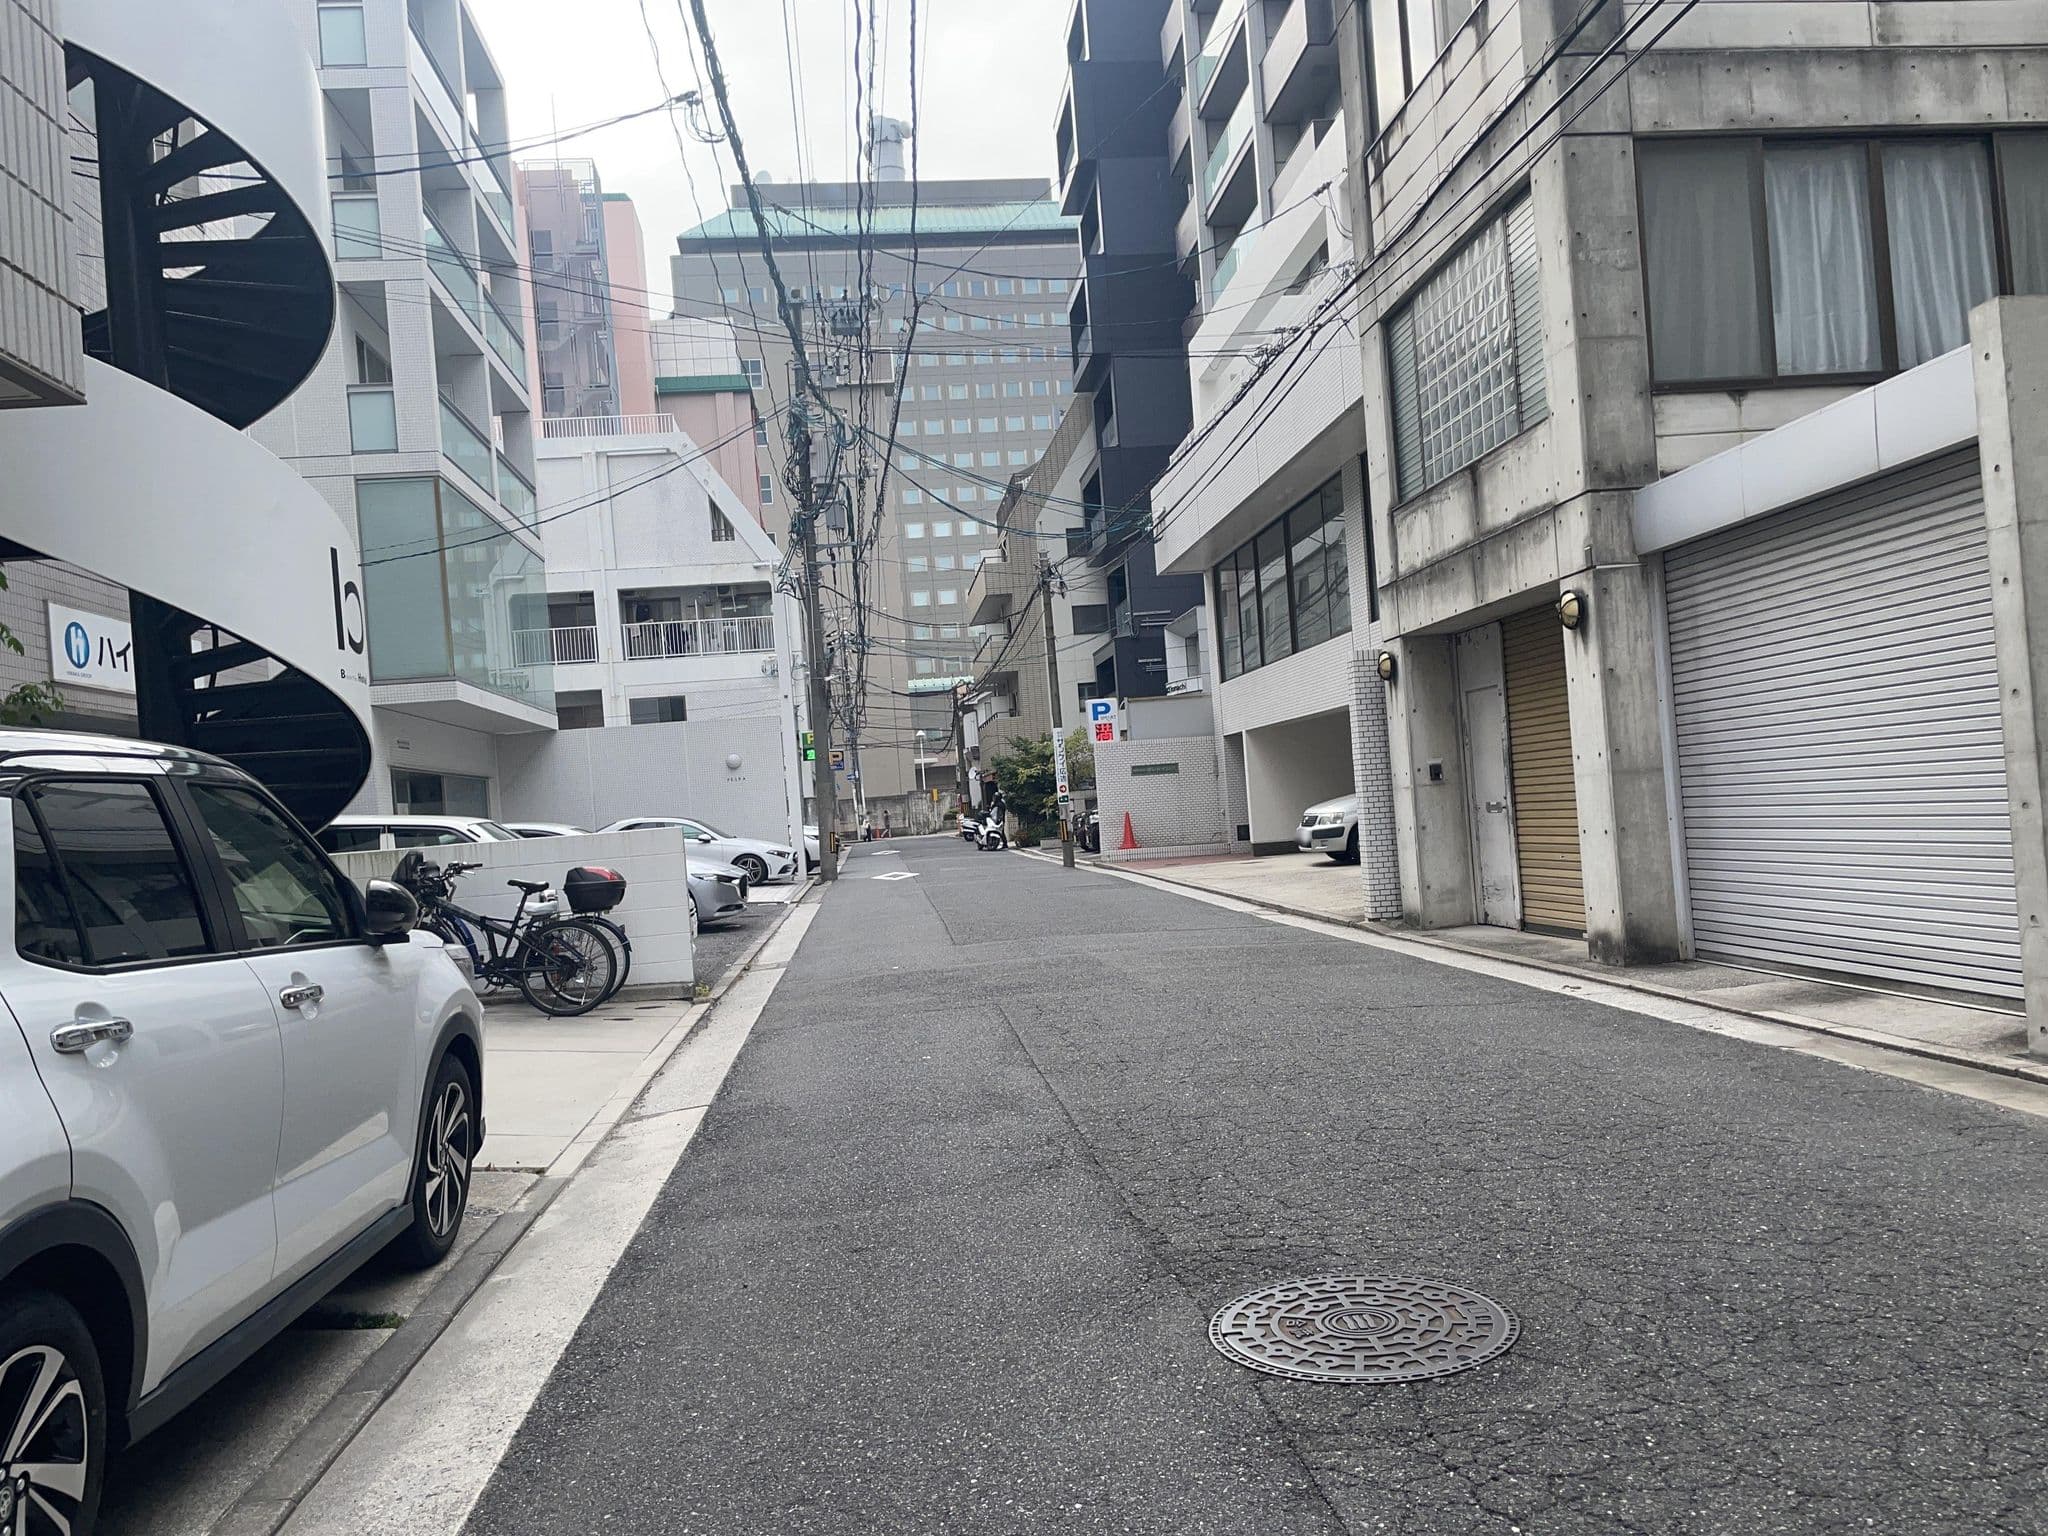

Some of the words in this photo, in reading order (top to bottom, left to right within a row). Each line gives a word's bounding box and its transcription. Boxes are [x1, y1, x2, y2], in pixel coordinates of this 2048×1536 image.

[98, 636, 131, 673] ハイ
[1092, 702, 1111, 721] P
[1095, 723, 1113, 742] 満
